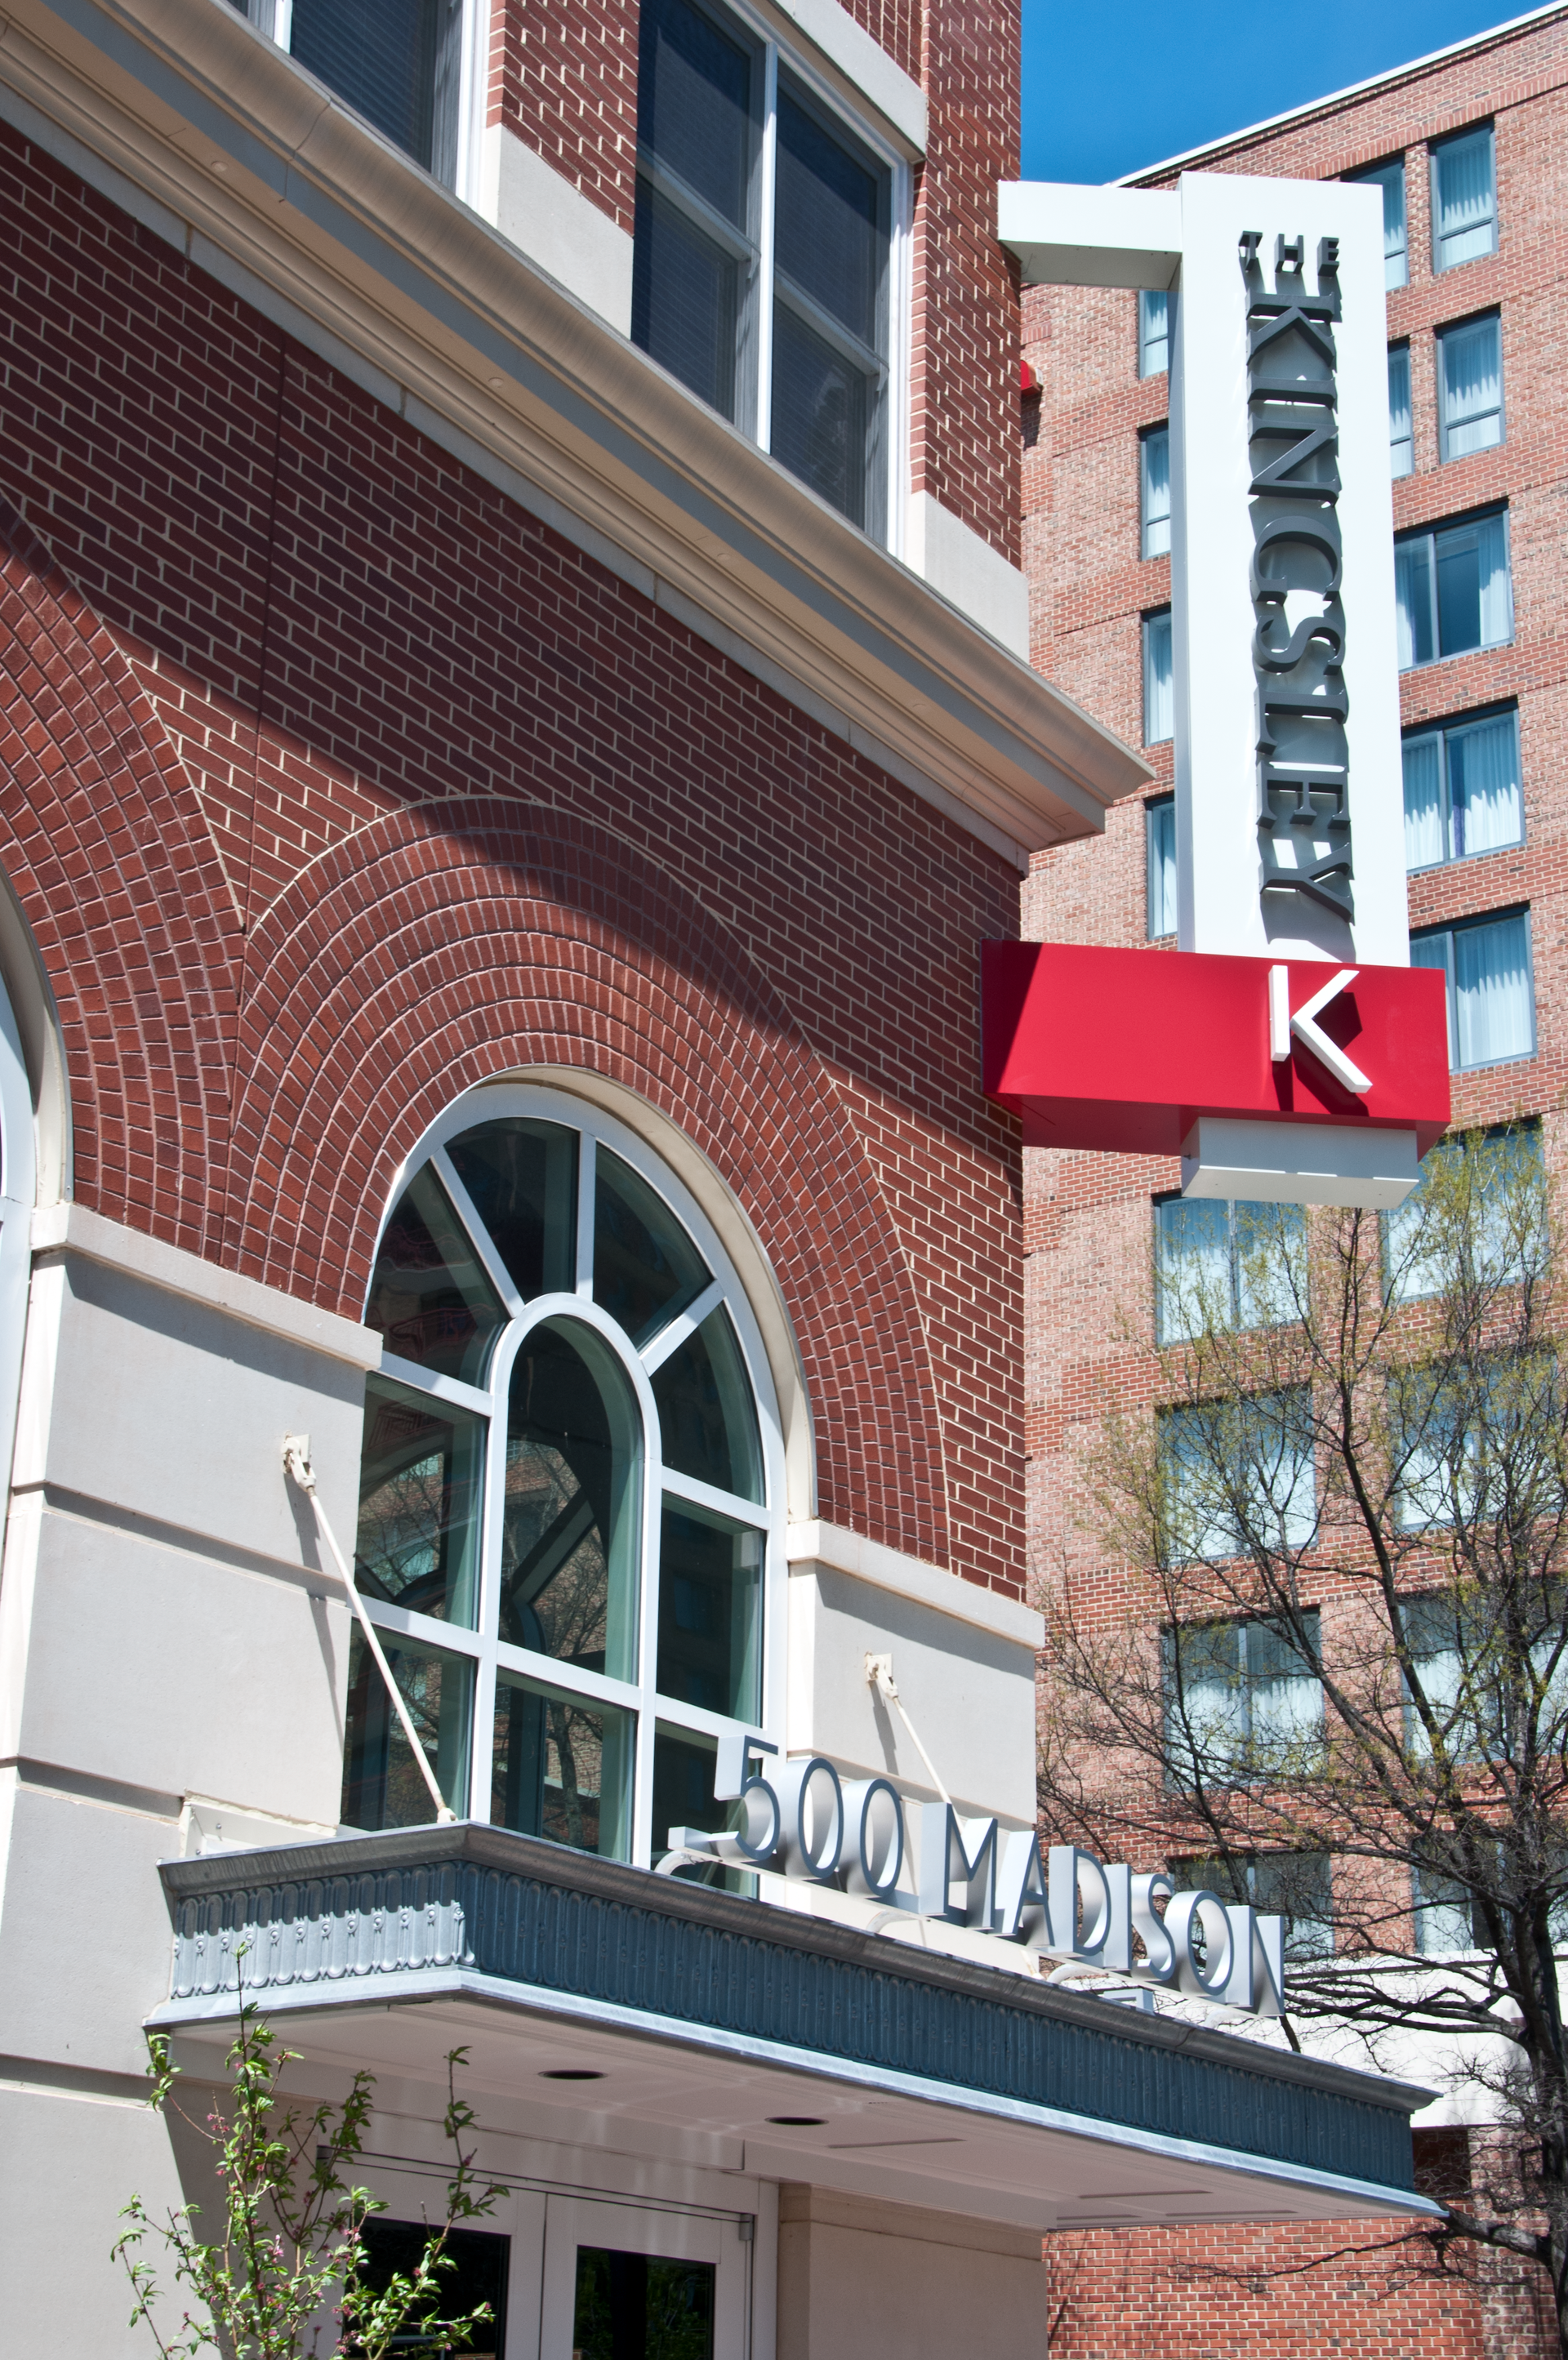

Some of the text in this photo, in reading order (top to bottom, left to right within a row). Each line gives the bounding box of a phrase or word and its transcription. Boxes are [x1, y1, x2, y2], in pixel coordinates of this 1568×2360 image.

[1238, 231, 1339, 277] THE
[1246, 292, 1353, 924] KINGSLEY
[1268, 965, 1373, 1093] K
[668, 1735, 1285, 2017] 500 MADISON
